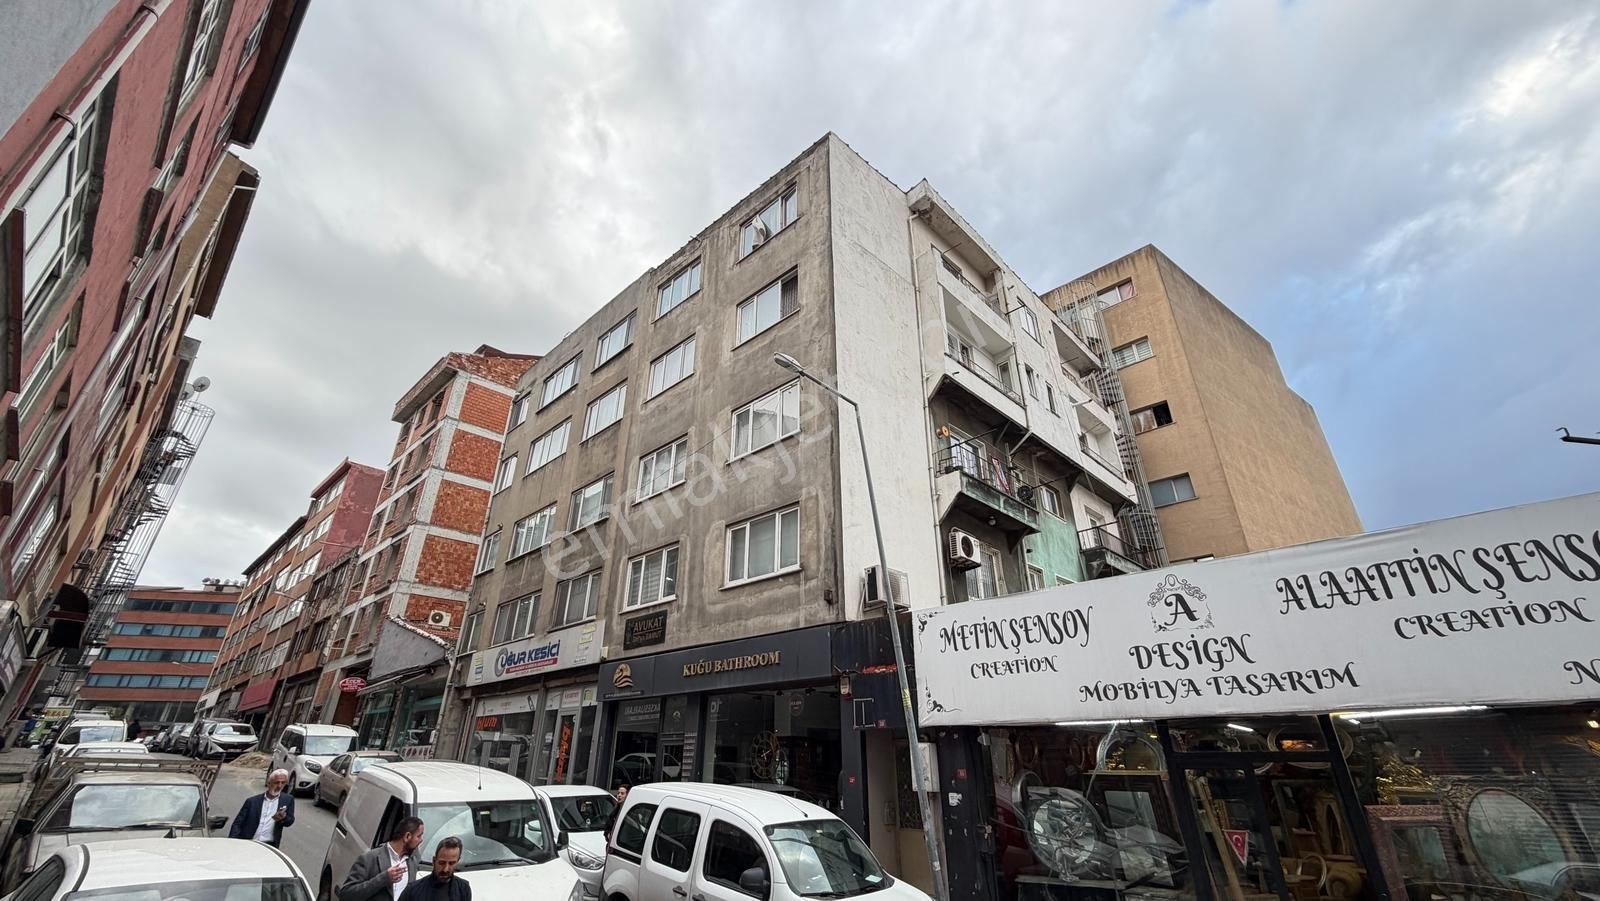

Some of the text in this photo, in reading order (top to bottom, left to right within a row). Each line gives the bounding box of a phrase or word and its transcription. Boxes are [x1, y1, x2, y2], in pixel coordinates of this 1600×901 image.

[1276, 530, 1600, 615] ALAATTİN ŞENS
[633, 616, 664, 633] AVUKAT
[939, 605, 1094, 654] METİN ŞENSOY
[1394, 597, 1595, 640] CREATİON
[500, 651, 527, 668] UĞUR
[528, 639, 561, 663] KESİCİ
[683, 650, 781, 677] KUĞU BATHROOM
[970, 655, 1058, 679] CREATİON
[1129, 634, 1256, 672] DESİGN
[1079, 661, 1360, 704] MOBİLYA TASARIM
